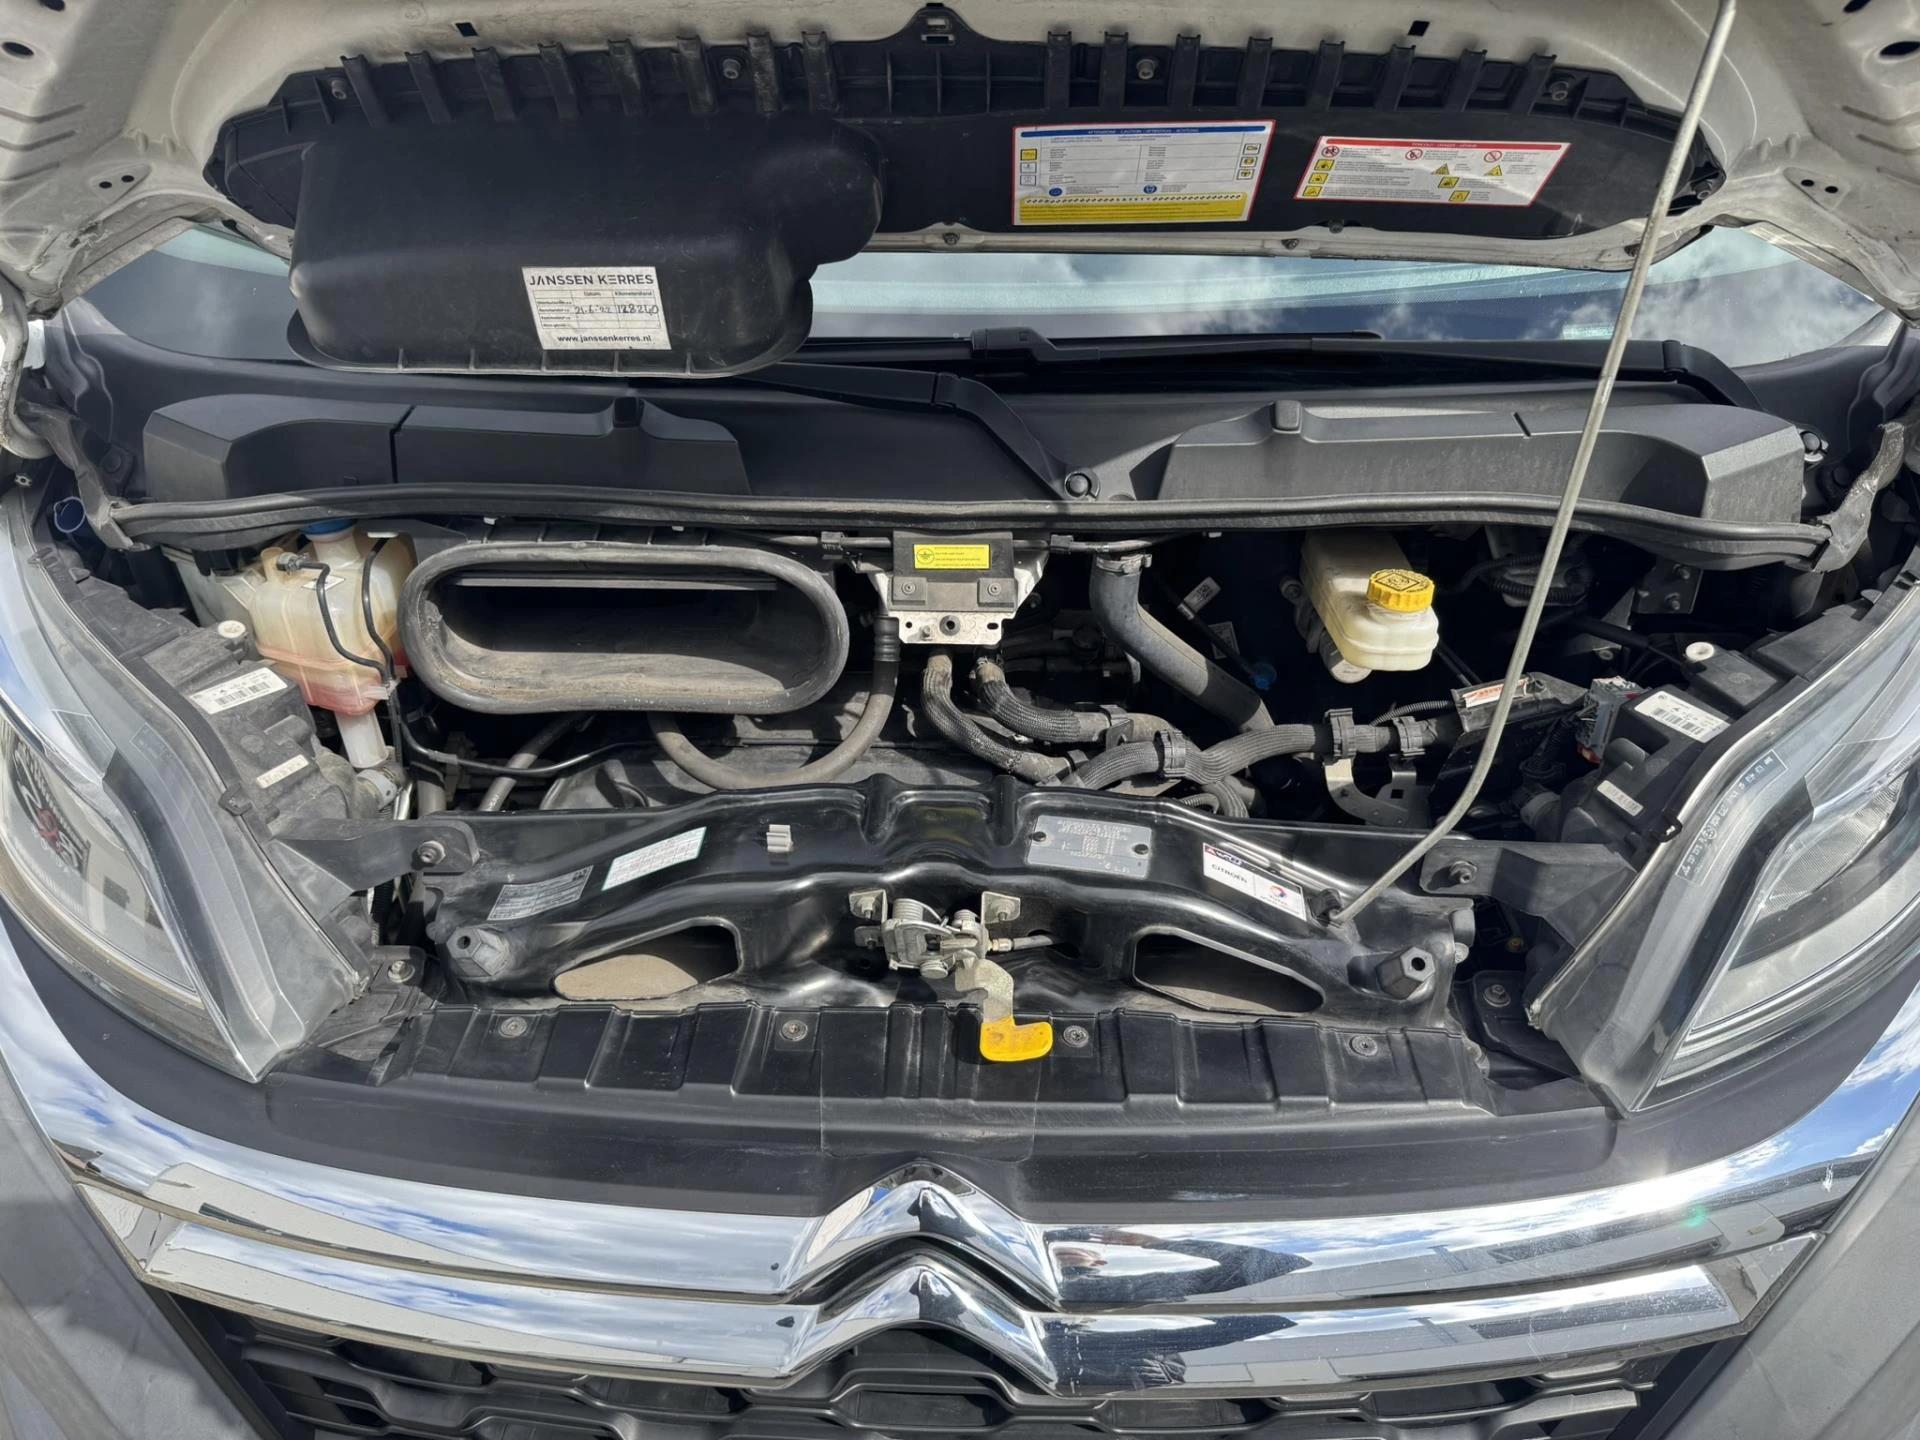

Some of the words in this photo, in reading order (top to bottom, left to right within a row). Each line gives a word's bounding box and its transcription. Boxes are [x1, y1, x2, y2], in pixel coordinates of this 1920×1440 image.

[529, 275, 594, 286] JANSSEN
[599, 274, 654, 285] KERRES
[557, 335, 652, 343] www.janssenkerres.nl
